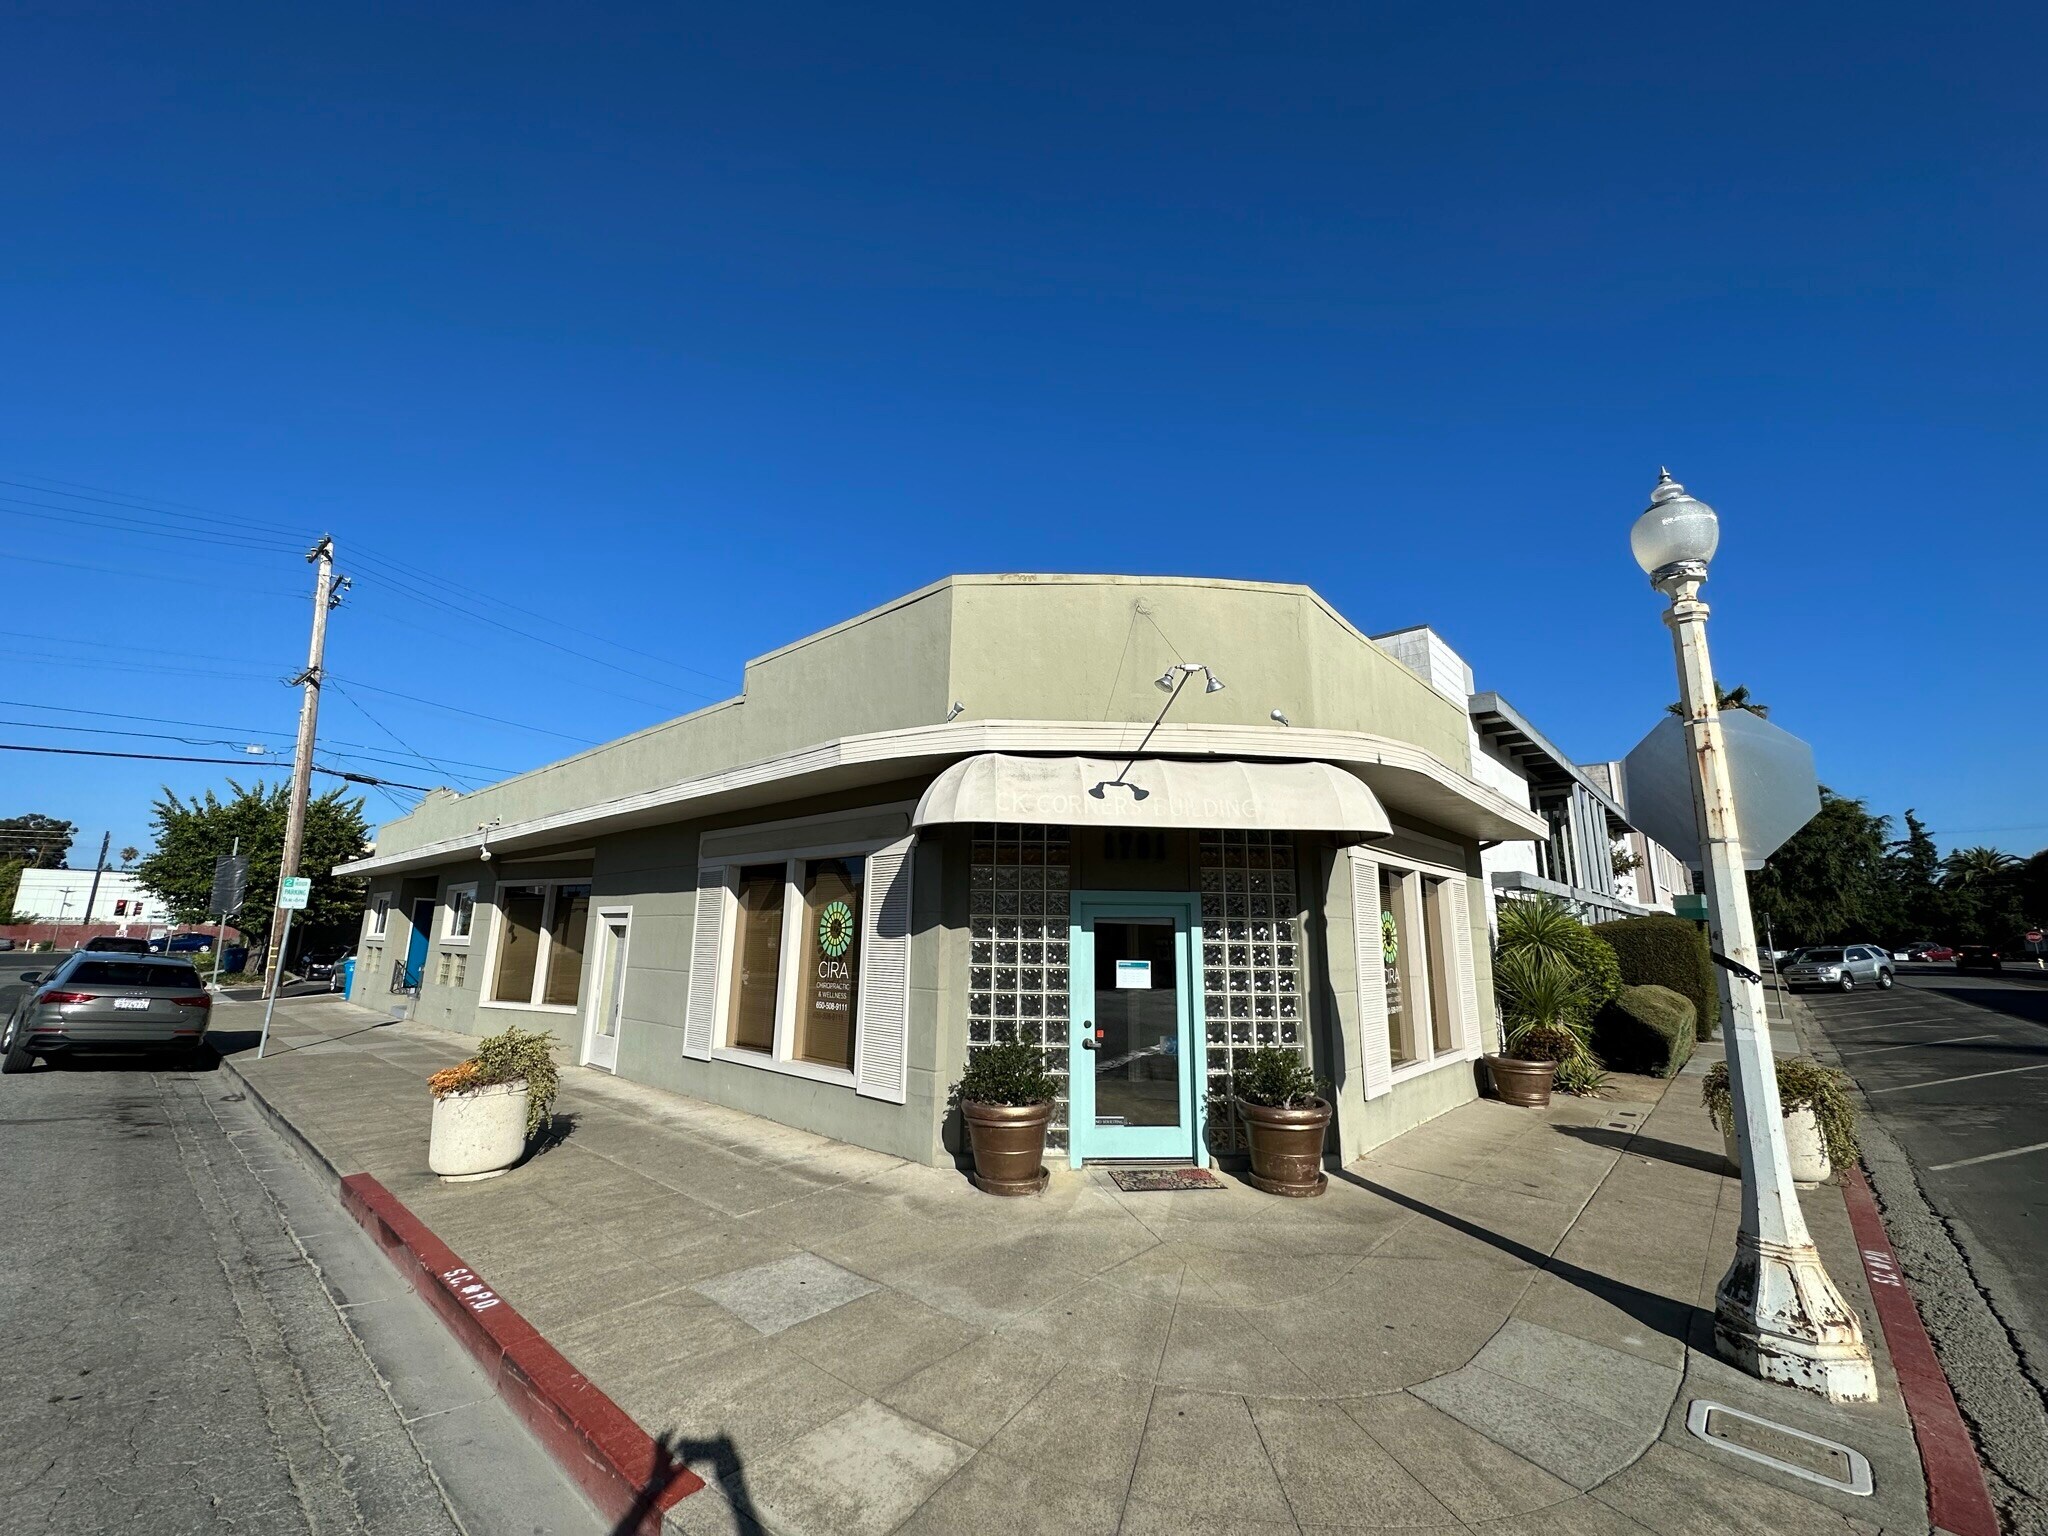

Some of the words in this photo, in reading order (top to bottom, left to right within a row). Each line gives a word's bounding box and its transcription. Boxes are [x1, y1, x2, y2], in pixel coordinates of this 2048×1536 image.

[1036, 794, 1143, 816] CORNERS
[818, 961, 849, 979] CIRA
[816, 981, 850, 990] CHIROPRACTIC
[822, 991, 847, 999] WELLNESS
[815, 1001, 848, 1011] 650-508-9111
